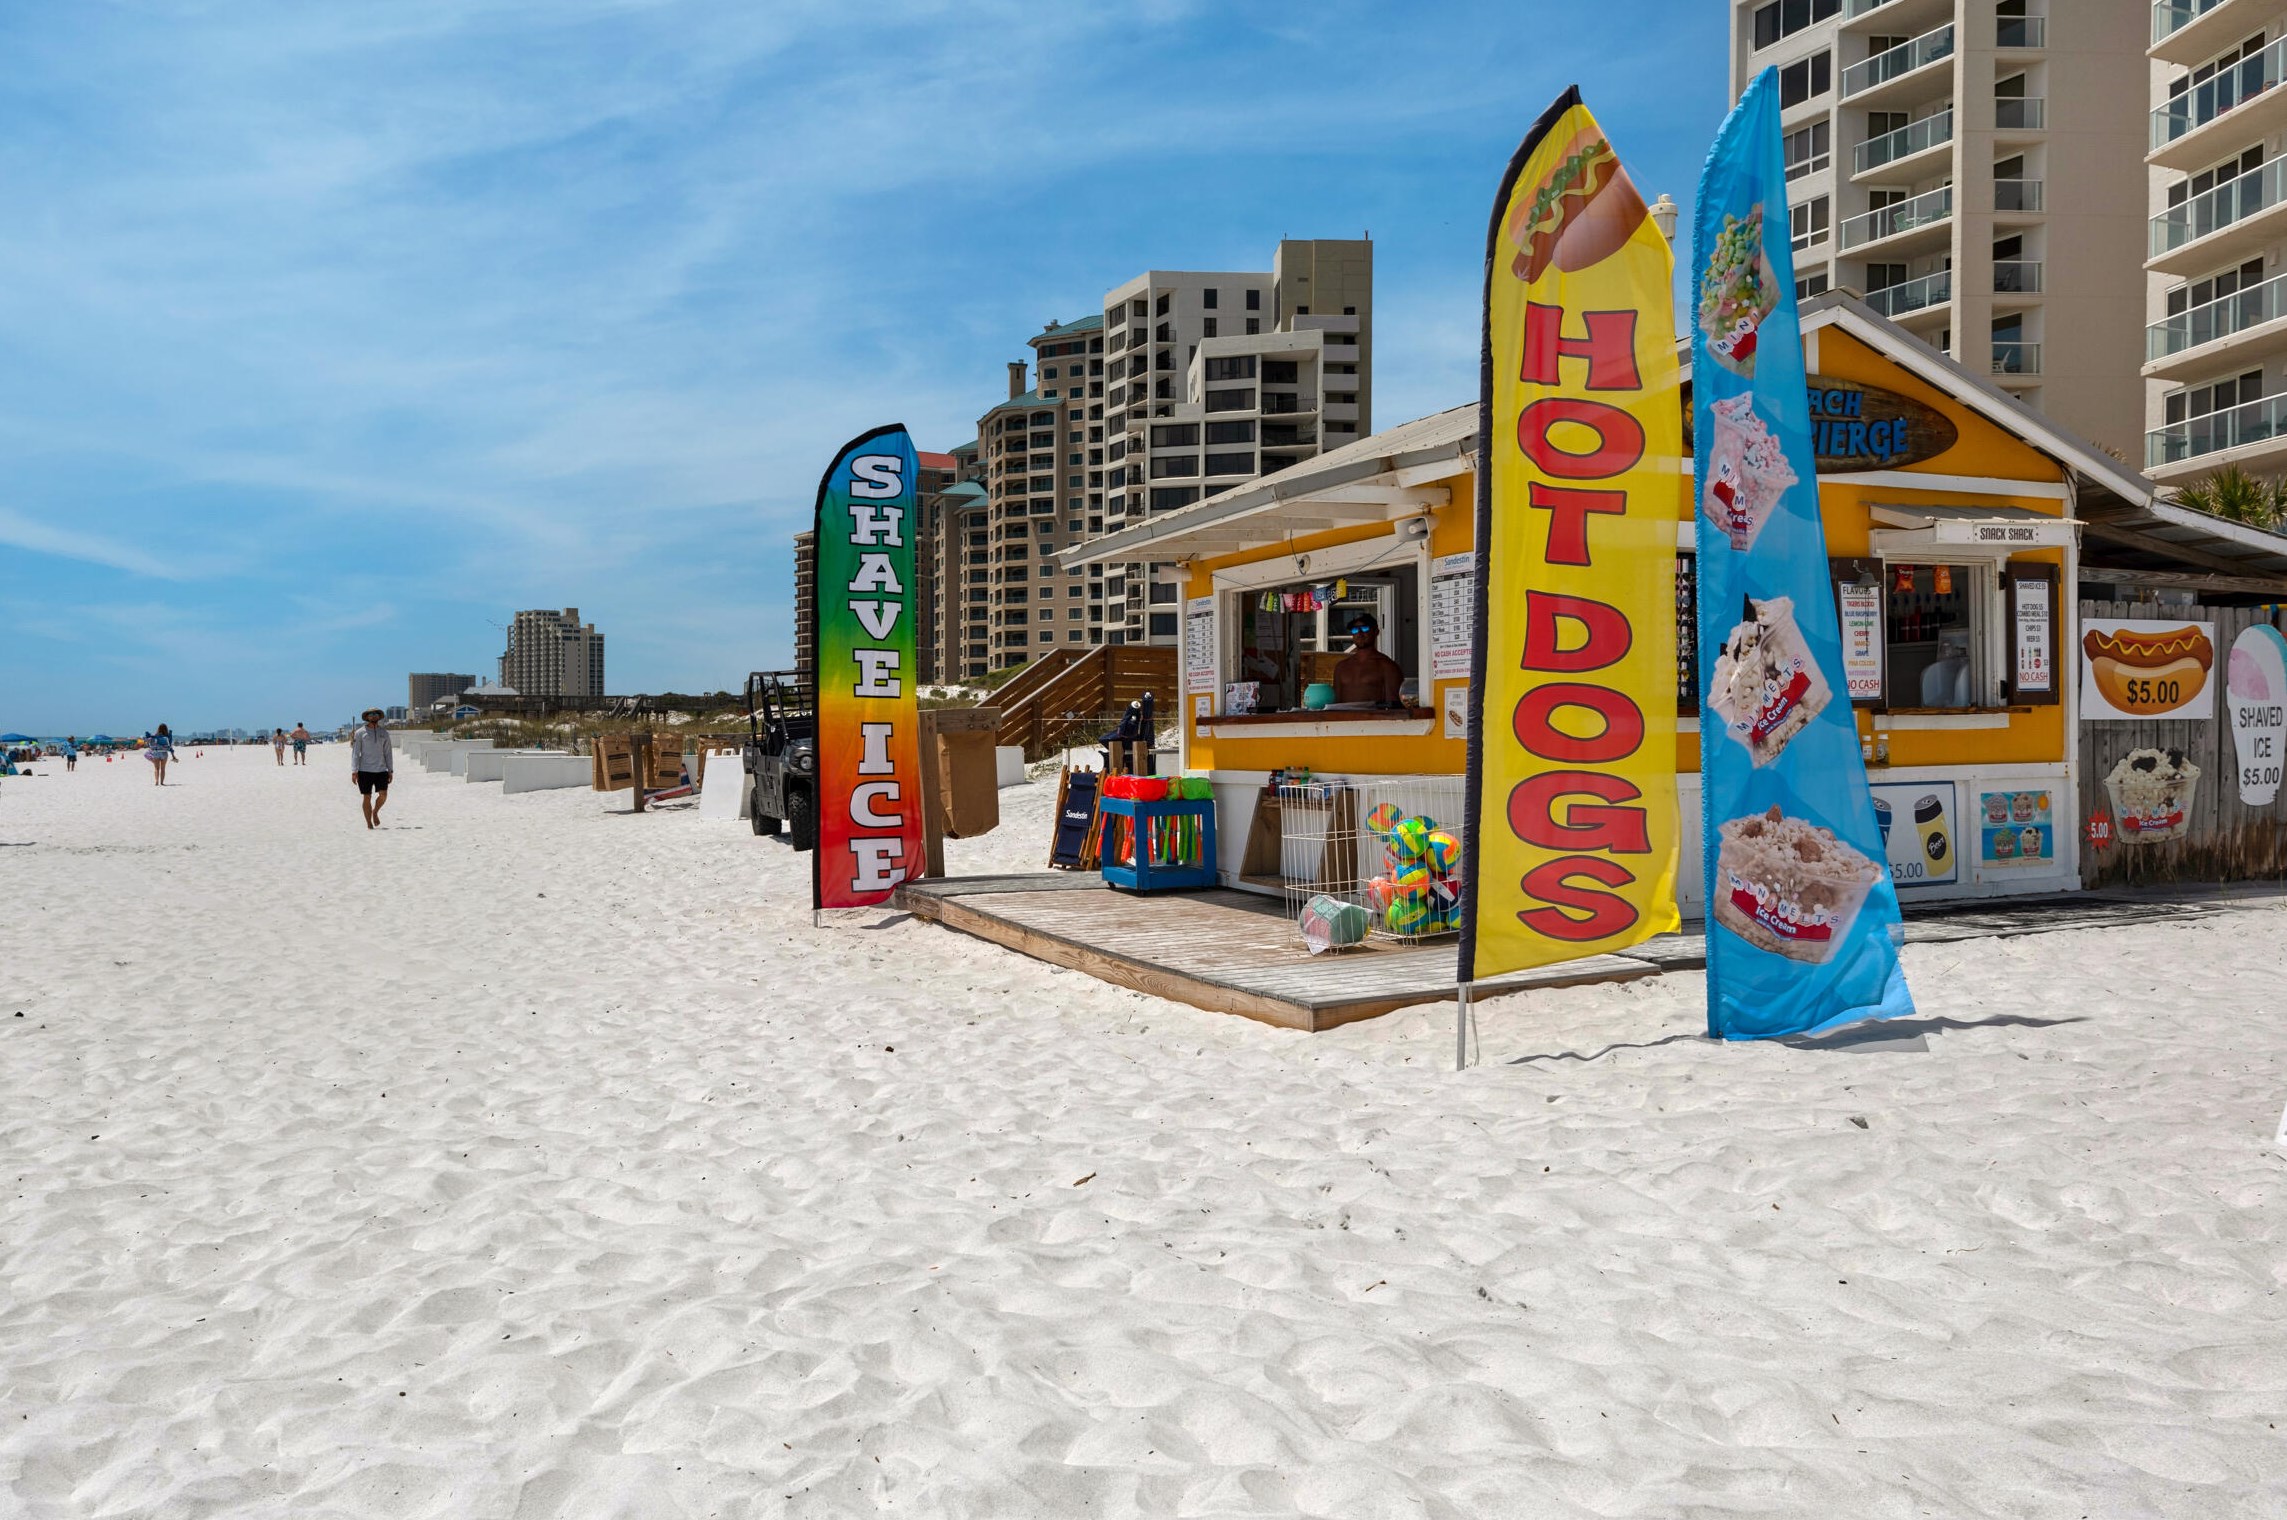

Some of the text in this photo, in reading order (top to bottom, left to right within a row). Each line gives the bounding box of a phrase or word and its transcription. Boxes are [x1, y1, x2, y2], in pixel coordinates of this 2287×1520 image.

[1717, 312, 1758, 352] MINI
[1807, 389, 1863, 417] ACH
[1811, 420, 1909, 461] IERGE
[1980, 527, 2034, 541] SNACK SHACK
[1445, 556, 1469, 566] Sandestin
[1507, 301, 1652, 942] HOT DOGS
[848, 454, 906, 894] SHAVE ICE
[1763, 658, 1802, 704] MELTS
[1858, 679, 1879, 689] CASH
[2020, 672, 2048, 681] NO CASH
[2127, 679, 2179, 706] $5.00
[1766, 696, 1789, 719] Cream
[2239, 706, 2283, 728] SHAVED
[2253, 737, 2272, 758] ICE
[2243, 767, 2280, 788] $5.00
[1065, 809, 1088, 820] Sandestin
[2091, 822, 2109, 838] 5.00
[1730, 876, 1840, 924] MINI MELTS
[1755, 906, 1770, 920] Ice
[1770, 914, 1797, 934] Cream
